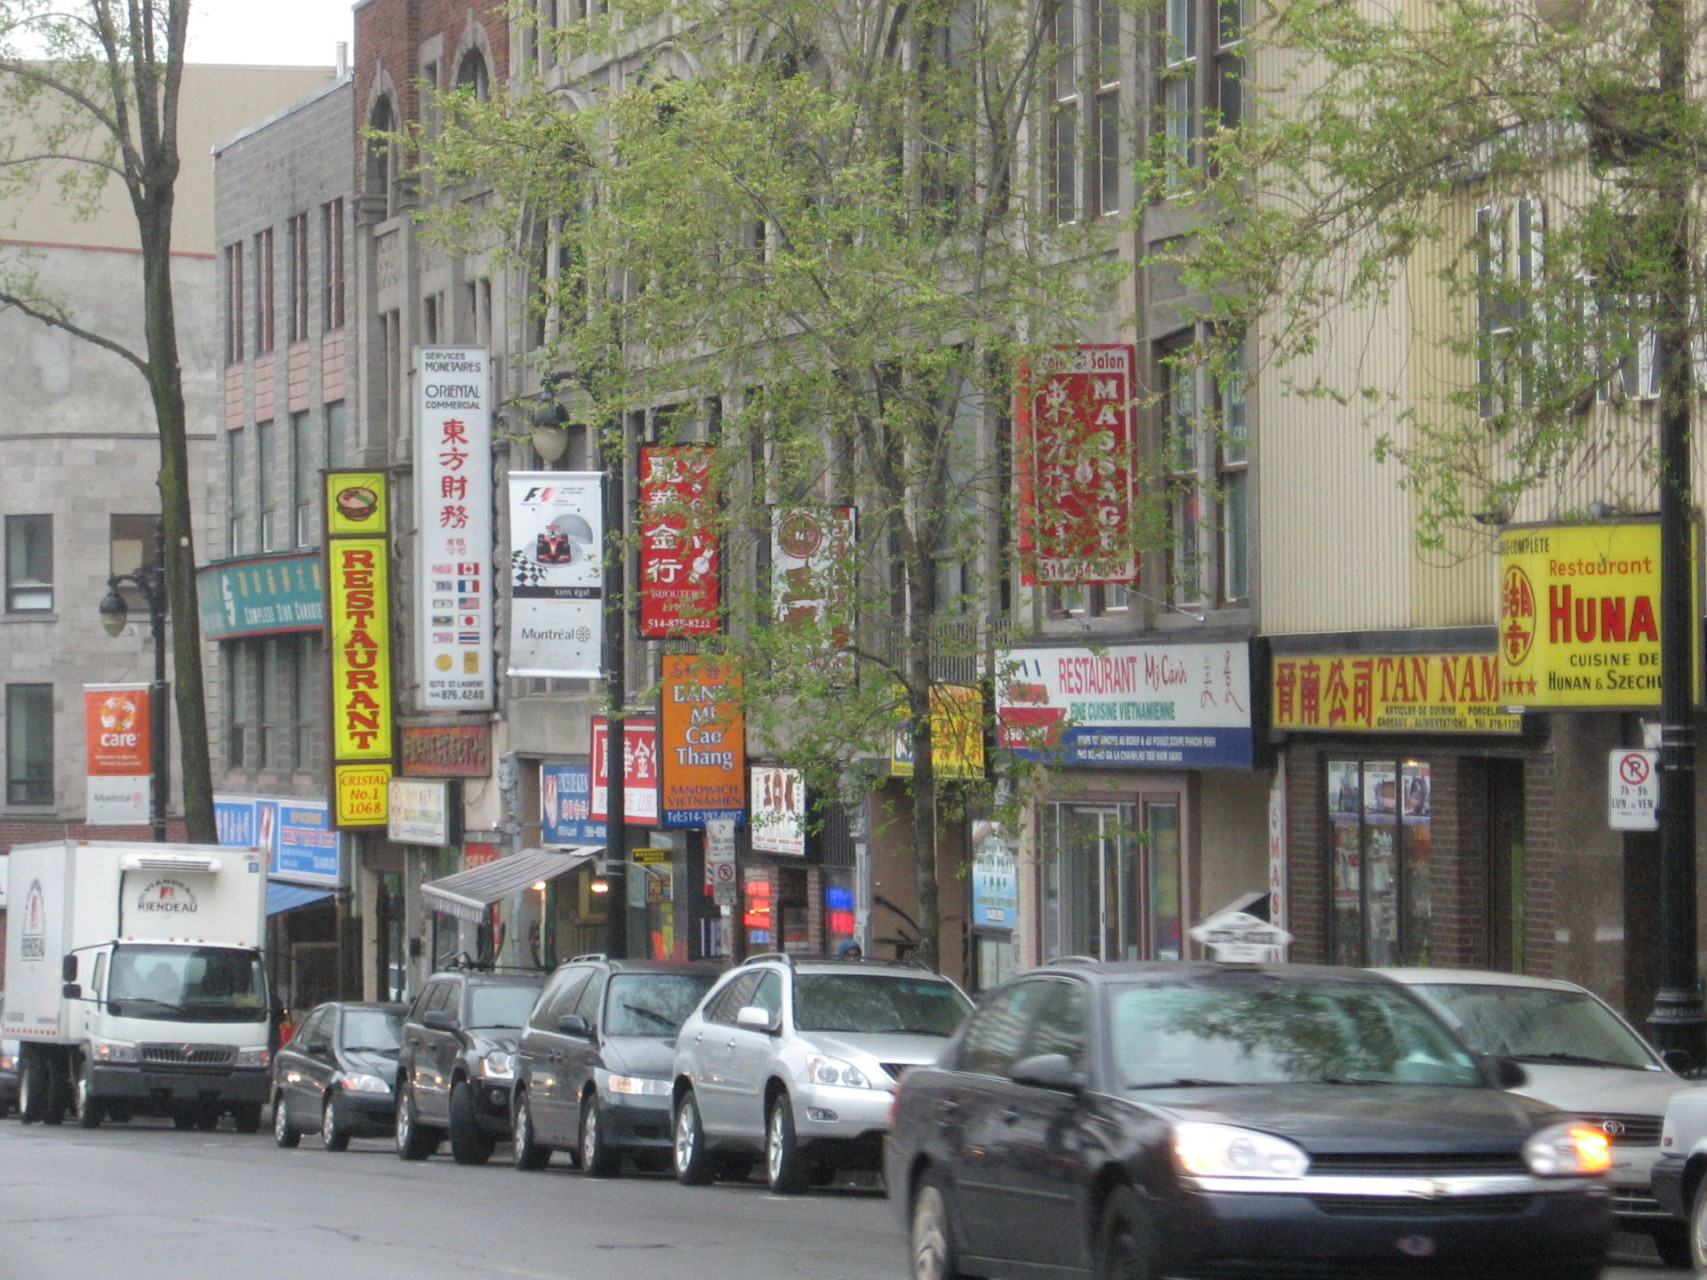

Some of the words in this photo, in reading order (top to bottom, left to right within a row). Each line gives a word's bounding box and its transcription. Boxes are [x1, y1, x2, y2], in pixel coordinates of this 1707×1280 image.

[425, 352, 466, 360] SERVICES
[1092, 352, 1124, 369] Salon
[425, 361, 481, 373] MONETAIRES
[425, 384, 481, 399] ORIENTAL
[425, 400, 481, 410] COMMERCIAL
[439, 418, 469, 529] 東方財務
[1550, 557, 1652, 577] Restaurant
[554, 589, 572, 597] sans
[574, 588, 591, 598] égal
[521, 628, 575, 640] Montréal
[342, 550, 380, 749] RESTAURANT
[1570, 654, 1631, 668] CUISINE
[1638, 653, 1660, 666] DE
[1058, 656, 1137, 695] RESTAURANT
[1377, 657, 1430, 702] TAN
[1440, 655, 1499, 702] NAM
[1548, 671, 1591, 690] HUNAN
[1594, 678, 1603, 690] &
[1088, 702, 1118, 721] CUISINE
[101, 733, 137, 746] care
[686, 726, 722, 744] Cao
[341, 775, 386, 786] CRISTAL
[670, 786, 741, 796] SANDWICH
[349, 802, 382, 814] 1068
[668, 796, 743, 806] VIETNAMIEN
[137, 902, 199, 913] RIENDEAU
